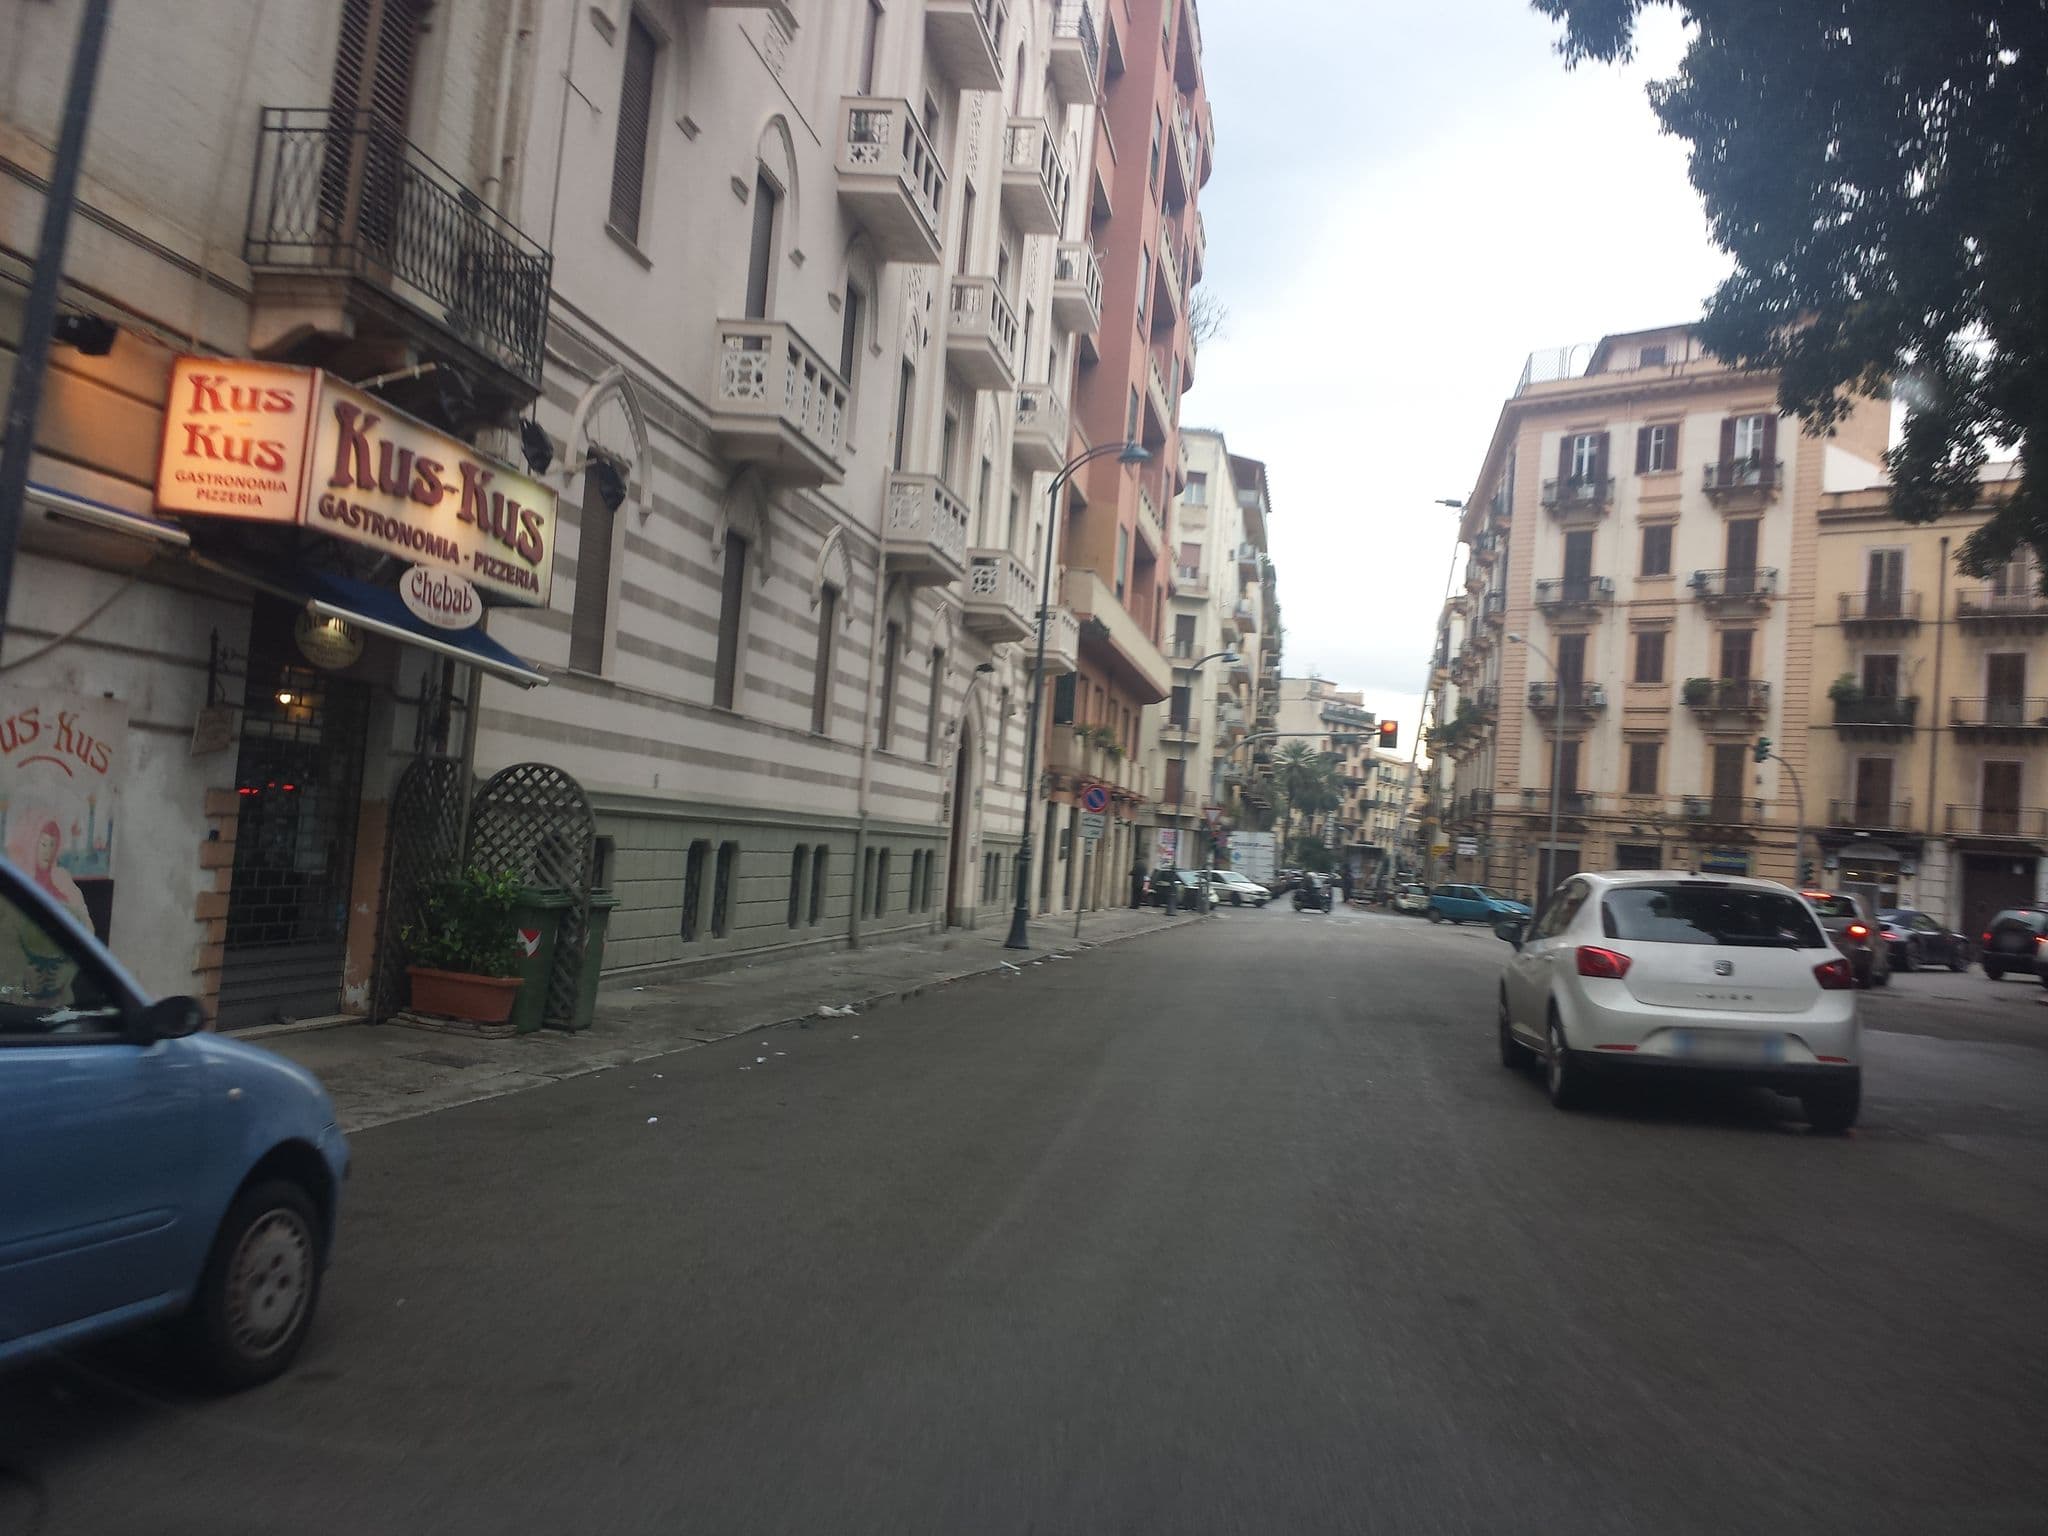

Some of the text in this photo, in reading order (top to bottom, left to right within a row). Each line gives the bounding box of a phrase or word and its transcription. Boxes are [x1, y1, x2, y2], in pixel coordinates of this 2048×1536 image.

[174, 468, 288, 494] GASTRONOMIA
[196, 486, 263, 507] PIZZERIA
[318, 493, 460, 565] GASTRONOMIA
[473, 551, 540, 593] PIZZERIA
[411, 570, 473, 614] Chebab
